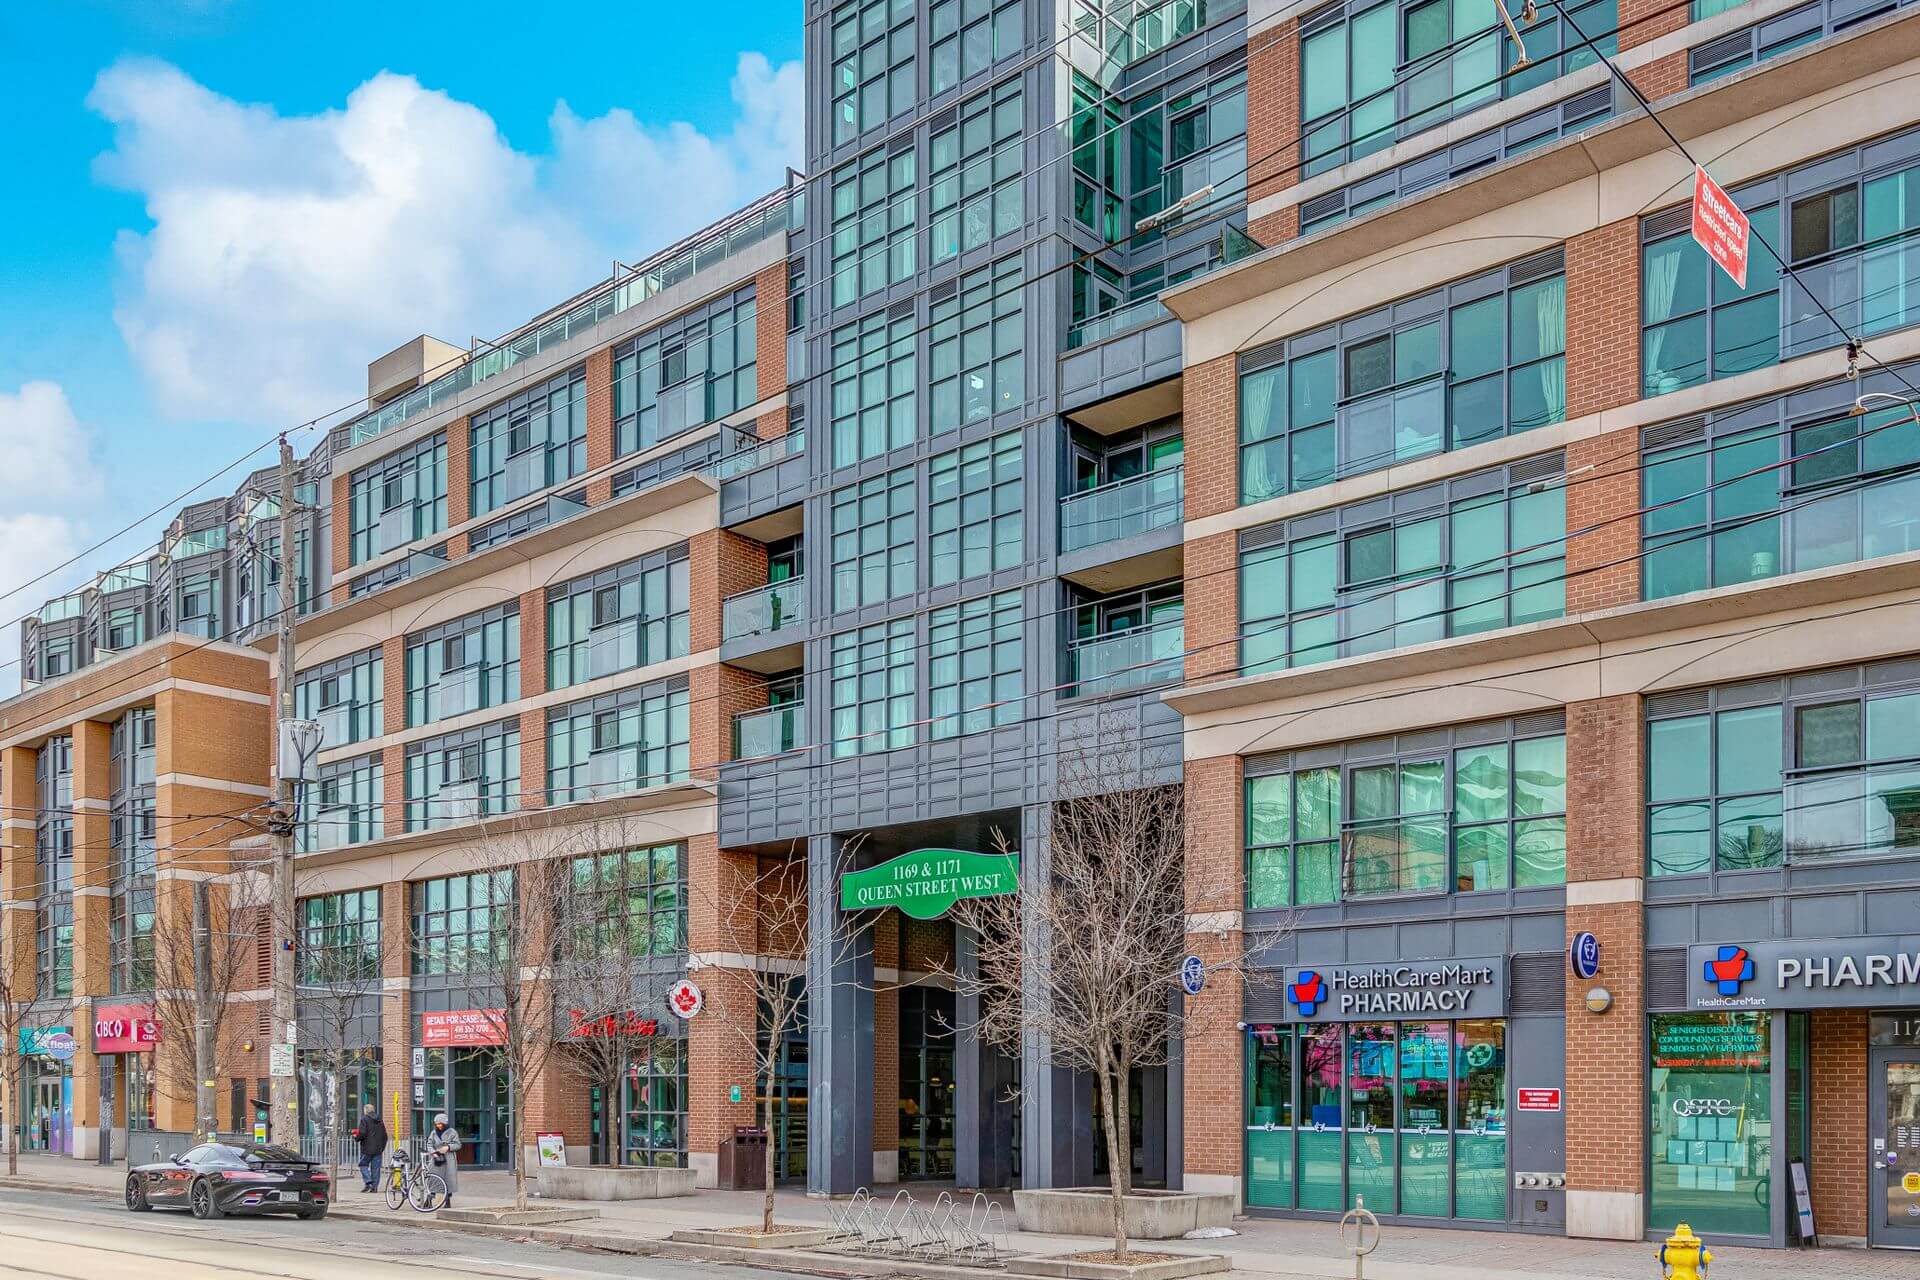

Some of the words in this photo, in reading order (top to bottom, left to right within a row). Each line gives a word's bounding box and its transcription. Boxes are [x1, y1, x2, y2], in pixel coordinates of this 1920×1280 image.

[1702, 183, 1742, 240] Streetcars
[893, 863, 918, 880] 1169
[921, 862, 932, 877] &
[936, 859, 961, 876] 1171
[857, 884, 902, 904] QUEEN
[905, 878, 958, 897] STREET
[960, 873, 1002, 891] WEST
[1332, 964, 1492, 990] HealthCareMart
[1777, 952, 1920, 989] PHARM
[1341, 989, 1472, 1014] PHARMACY
[1697, 996, 1766, 1007] HealthCareMart
[95, 1020, 114, 1038] CIBC
[1669, 1026, 1705, 1034] SENIORS
[1706, 1024, 1750, 1034] DISCOUNT
[1696, 1044, 1715, 1053] DAY
[1672, 1098, 1731, 1117] QSTC
